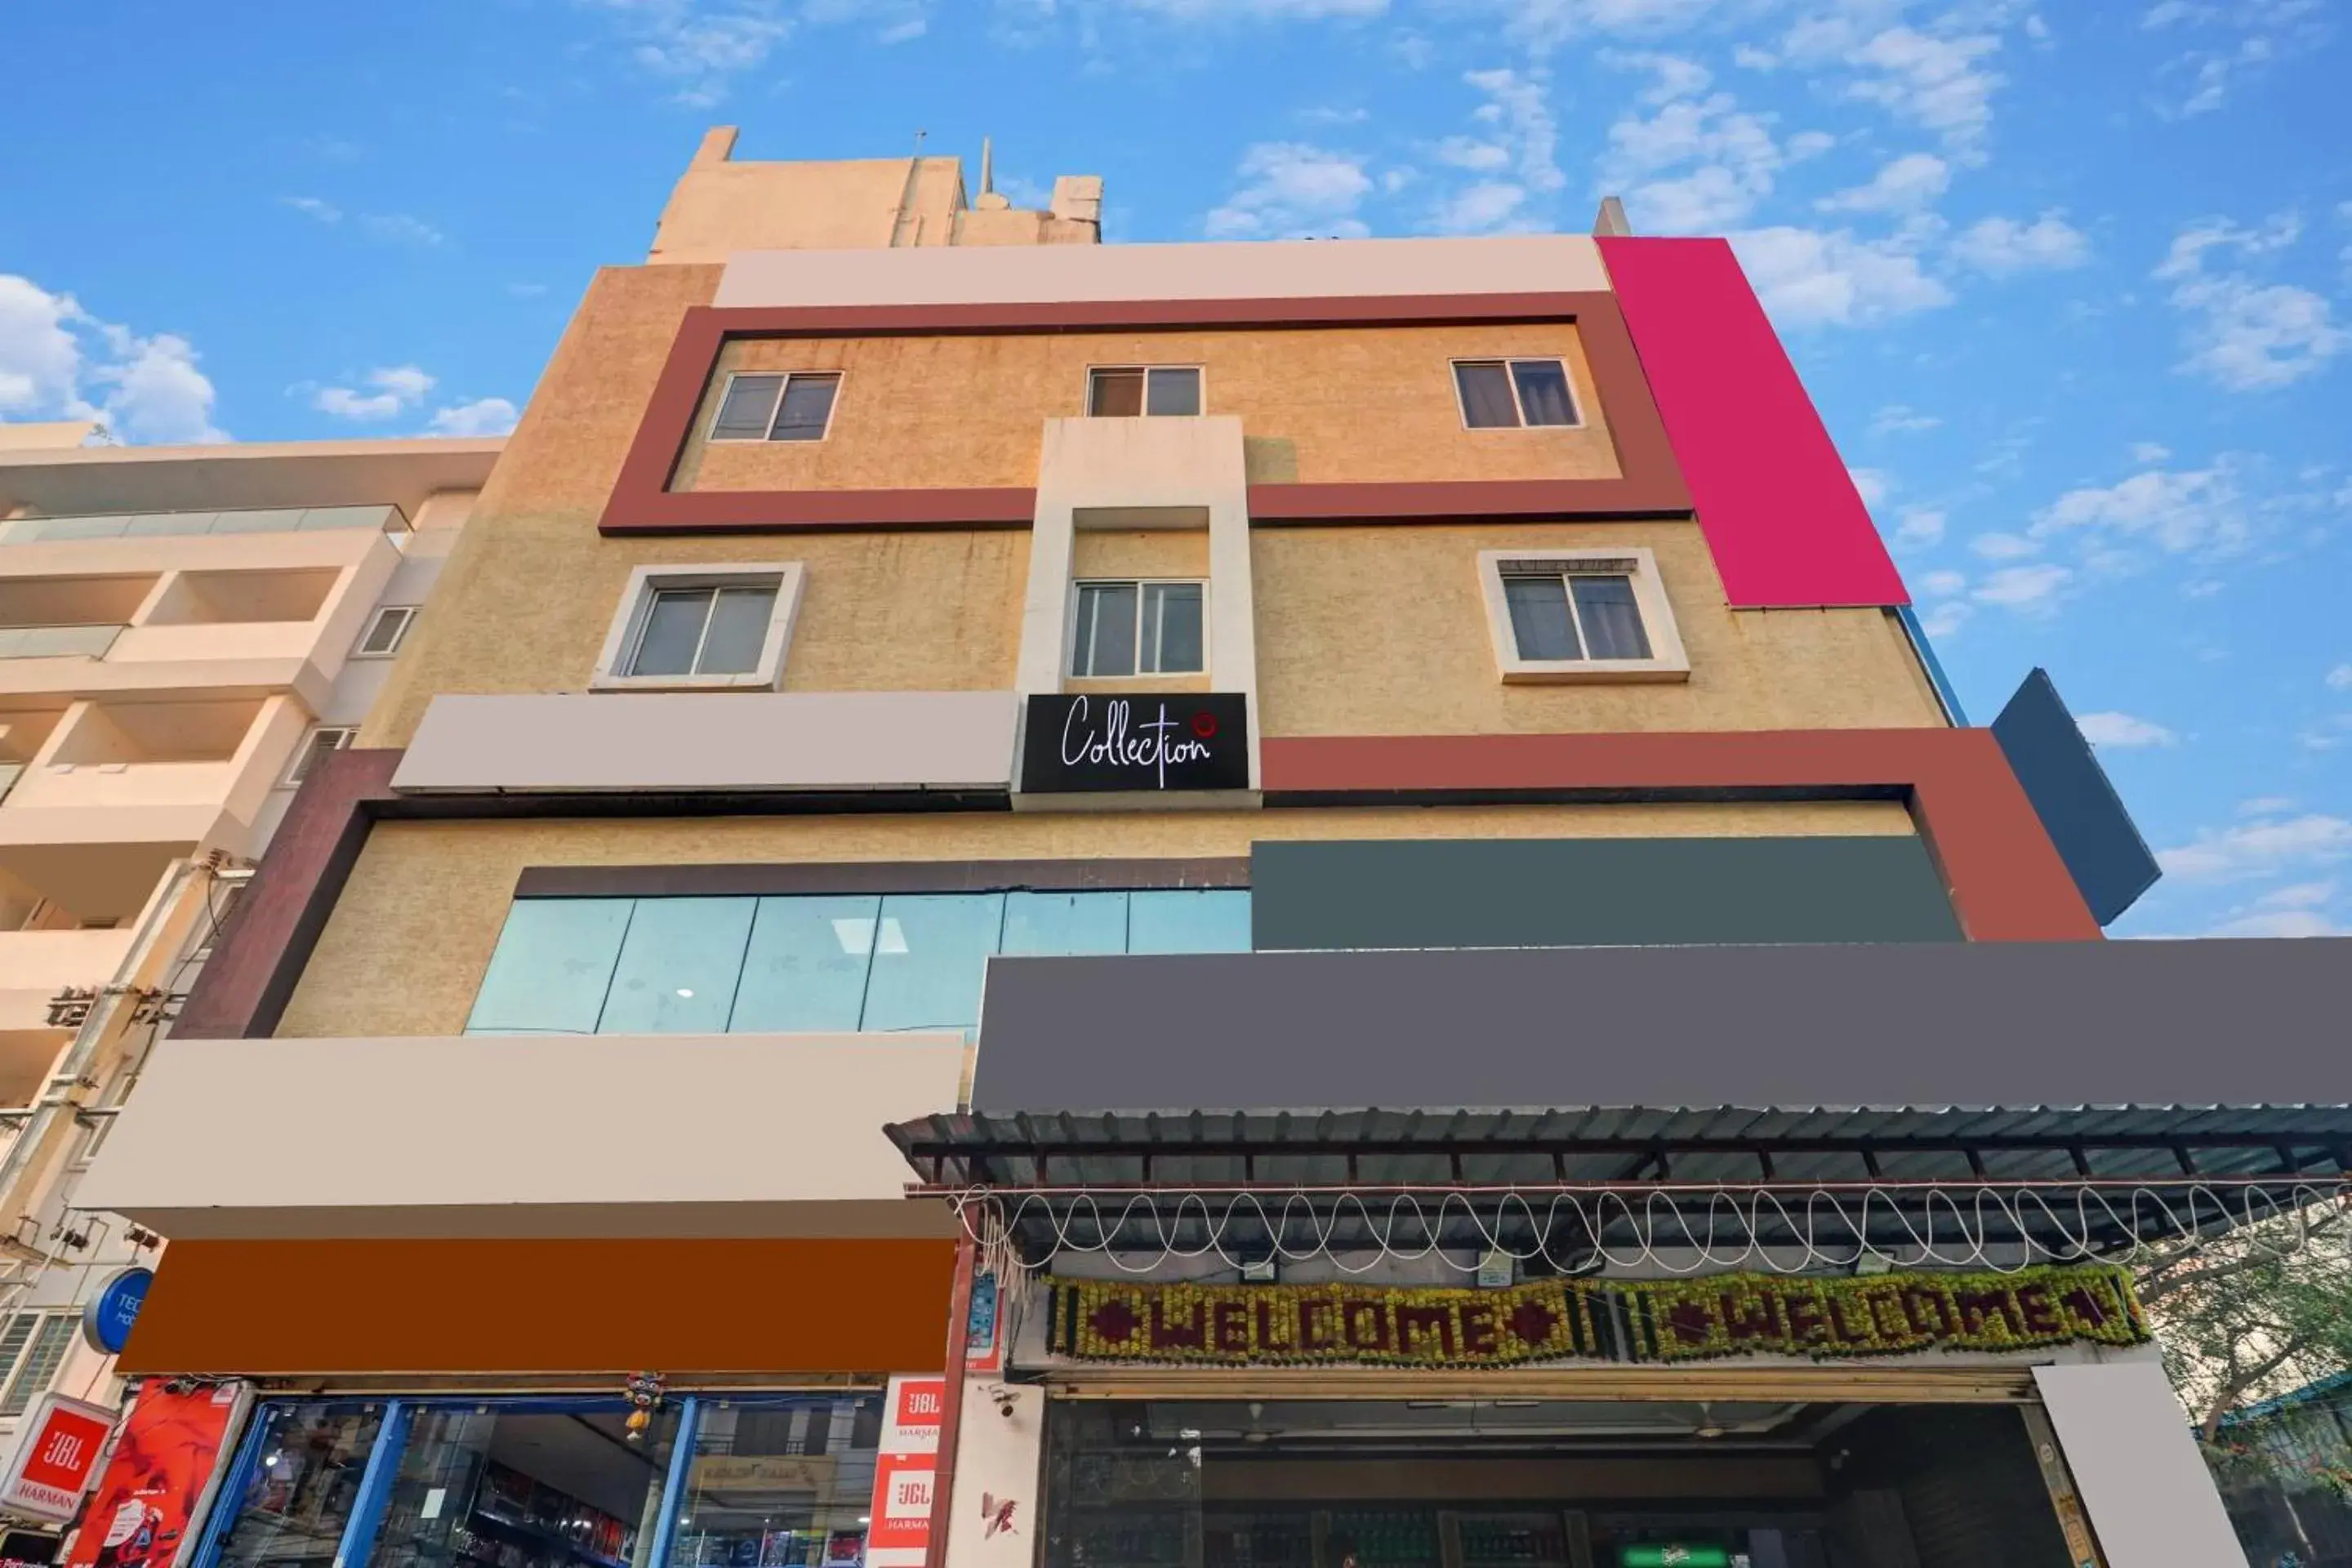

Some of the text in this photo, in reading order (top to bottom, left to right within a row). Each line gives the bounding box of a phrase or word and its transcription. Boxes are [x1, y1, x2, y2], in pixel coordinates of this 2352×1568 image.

[1062, 695, 1211, 790] Collection
[118, 1294, 144, 1315] TEC
[1720, 1284, 2063, 1341] WELCOME
[1150, 1299, 1498, 1358] WELCOME
[908, 1392, 940, 1414] JBL
[899, 1428, 938, 1437] HARMA
[43, 1431, 84, 1472] JBL
[19, 1483, 76, 1509] HARMAN
[898, 1482, 930, 1504] JBL
[889, 1518, 929, 1530] HARMA
